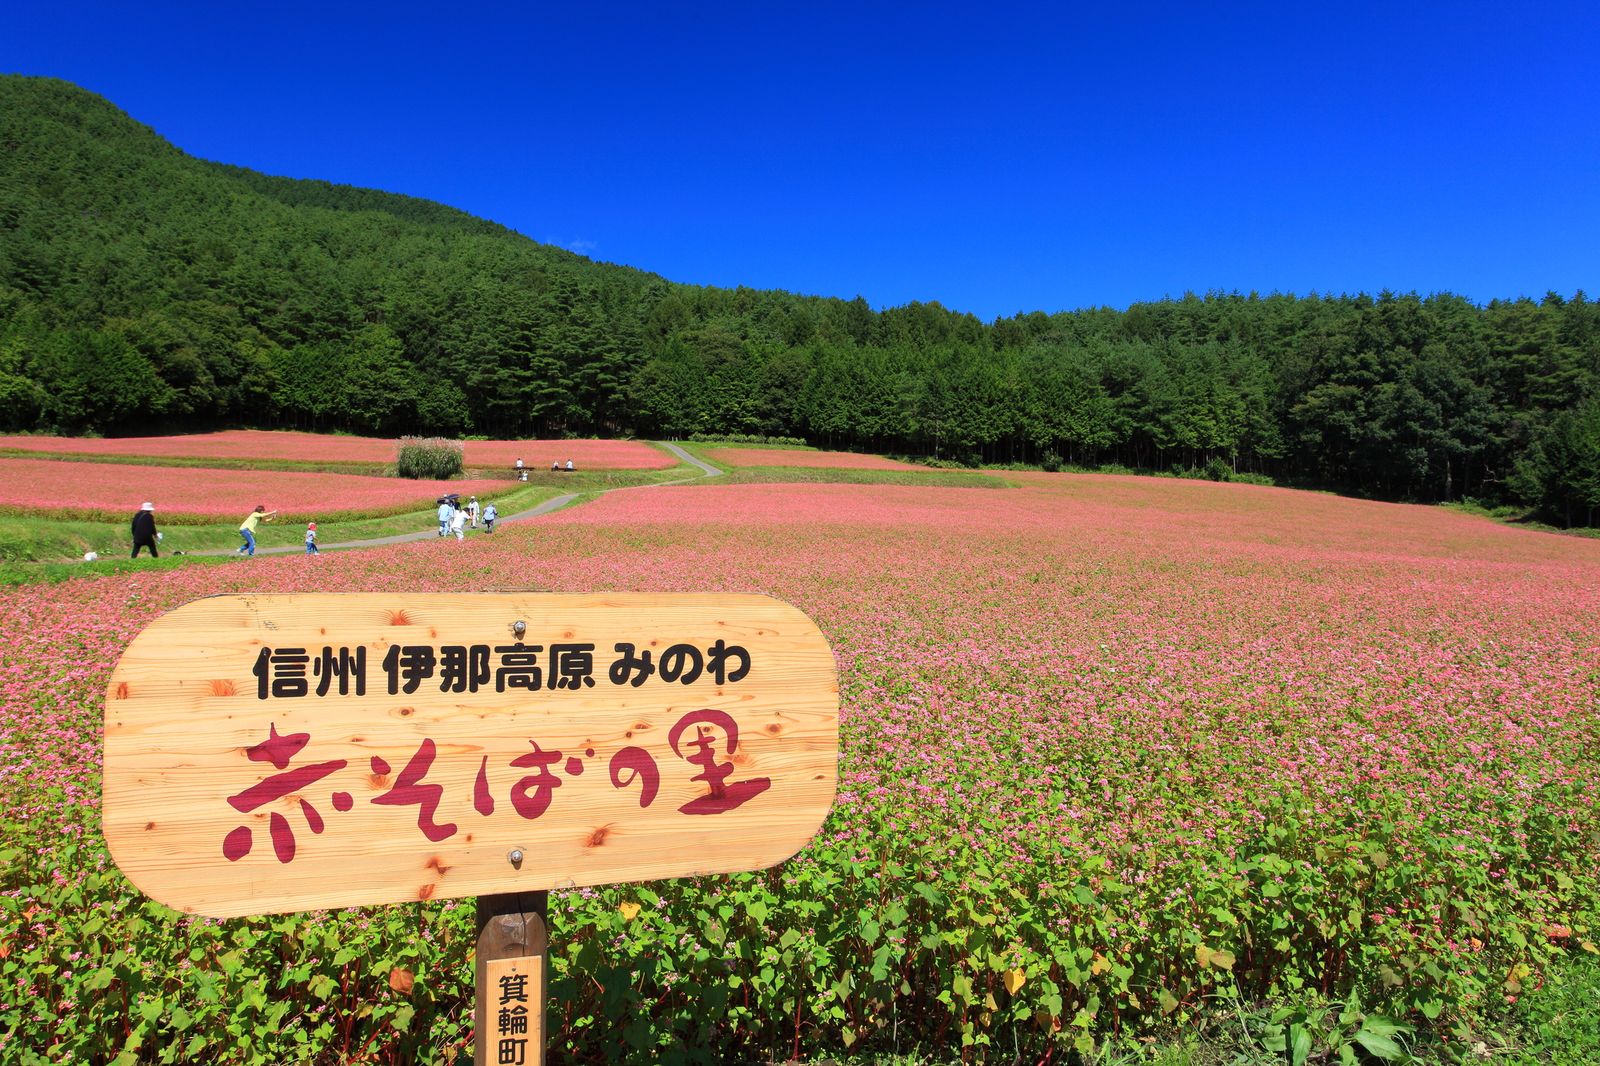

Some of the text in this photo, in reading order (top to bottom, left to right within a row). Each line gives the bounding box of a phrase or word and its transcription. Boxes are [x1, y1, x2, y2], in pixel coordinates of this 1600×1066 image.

[253, 640, 750, 699] 信州 伊那高原 みのわ
[223, 709, 771, 863] 赤そばの里
[498, 974, 528, 1066] 箕輪町
